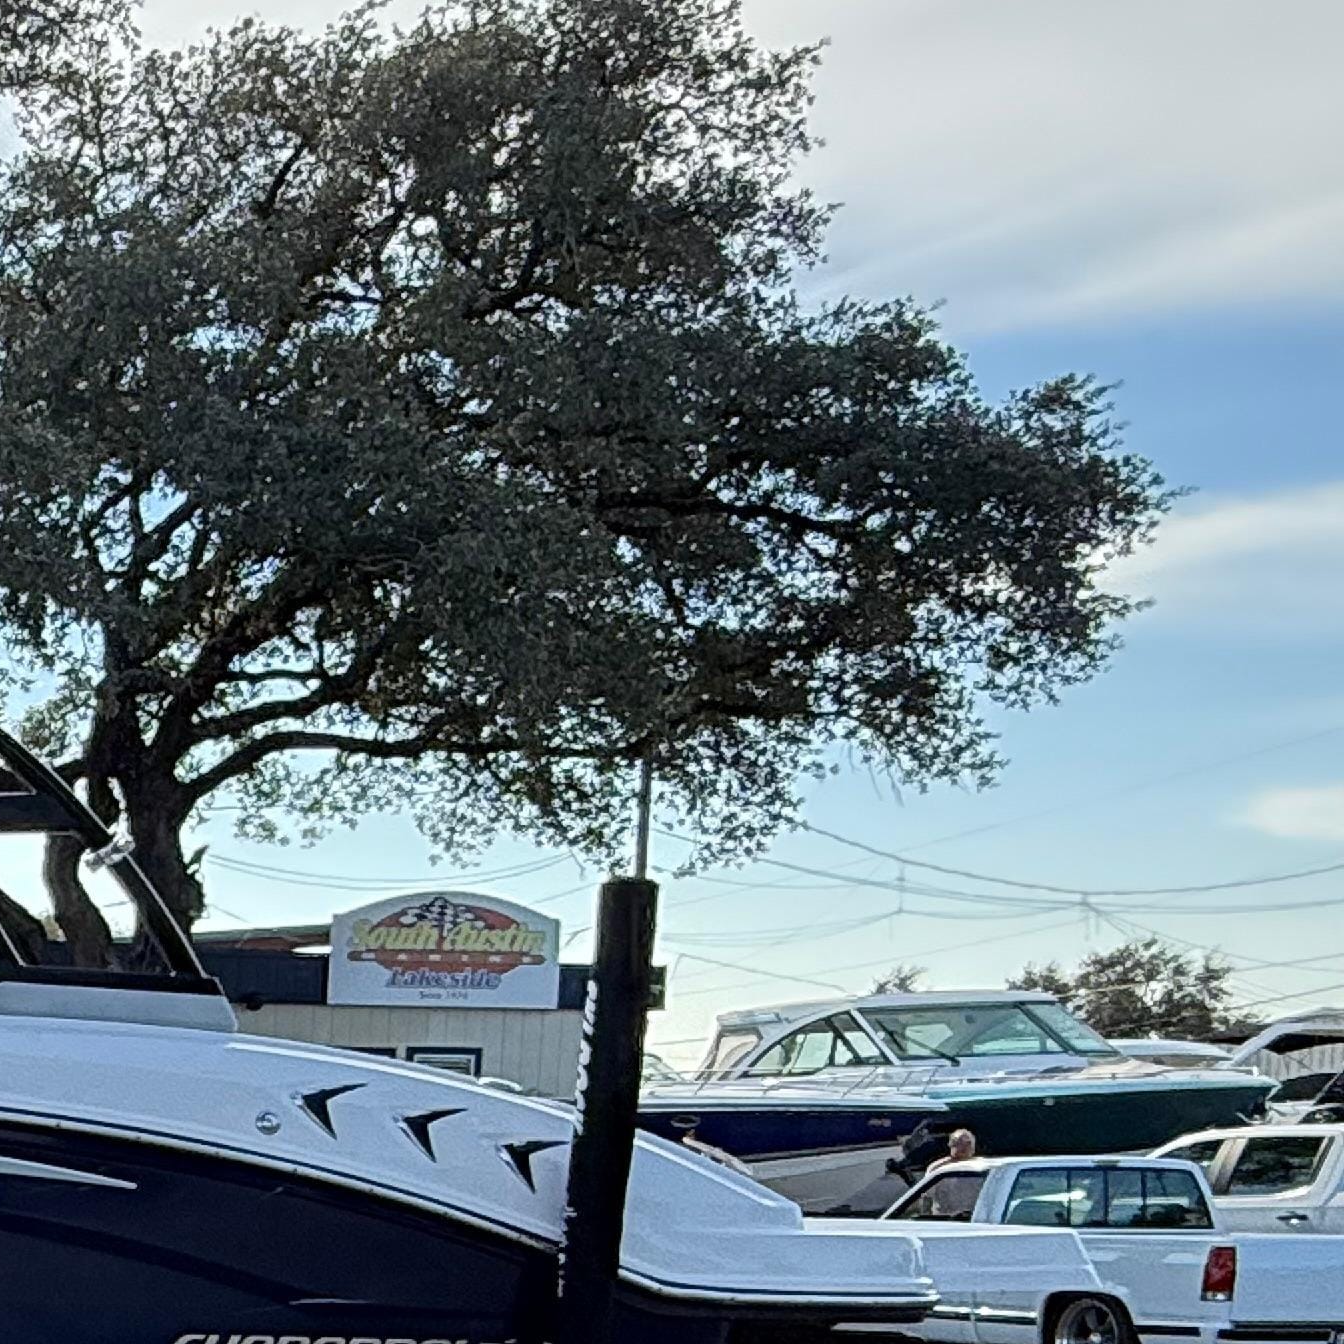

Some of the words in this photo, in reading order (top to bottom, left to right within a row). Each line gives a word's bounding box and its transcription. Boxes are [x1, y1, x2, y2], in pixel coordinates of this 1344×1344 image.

[350, 918, 439, 950] South
[442, 920, 545, 953] Austin
[387, 967, 502, 989] Lakeside
